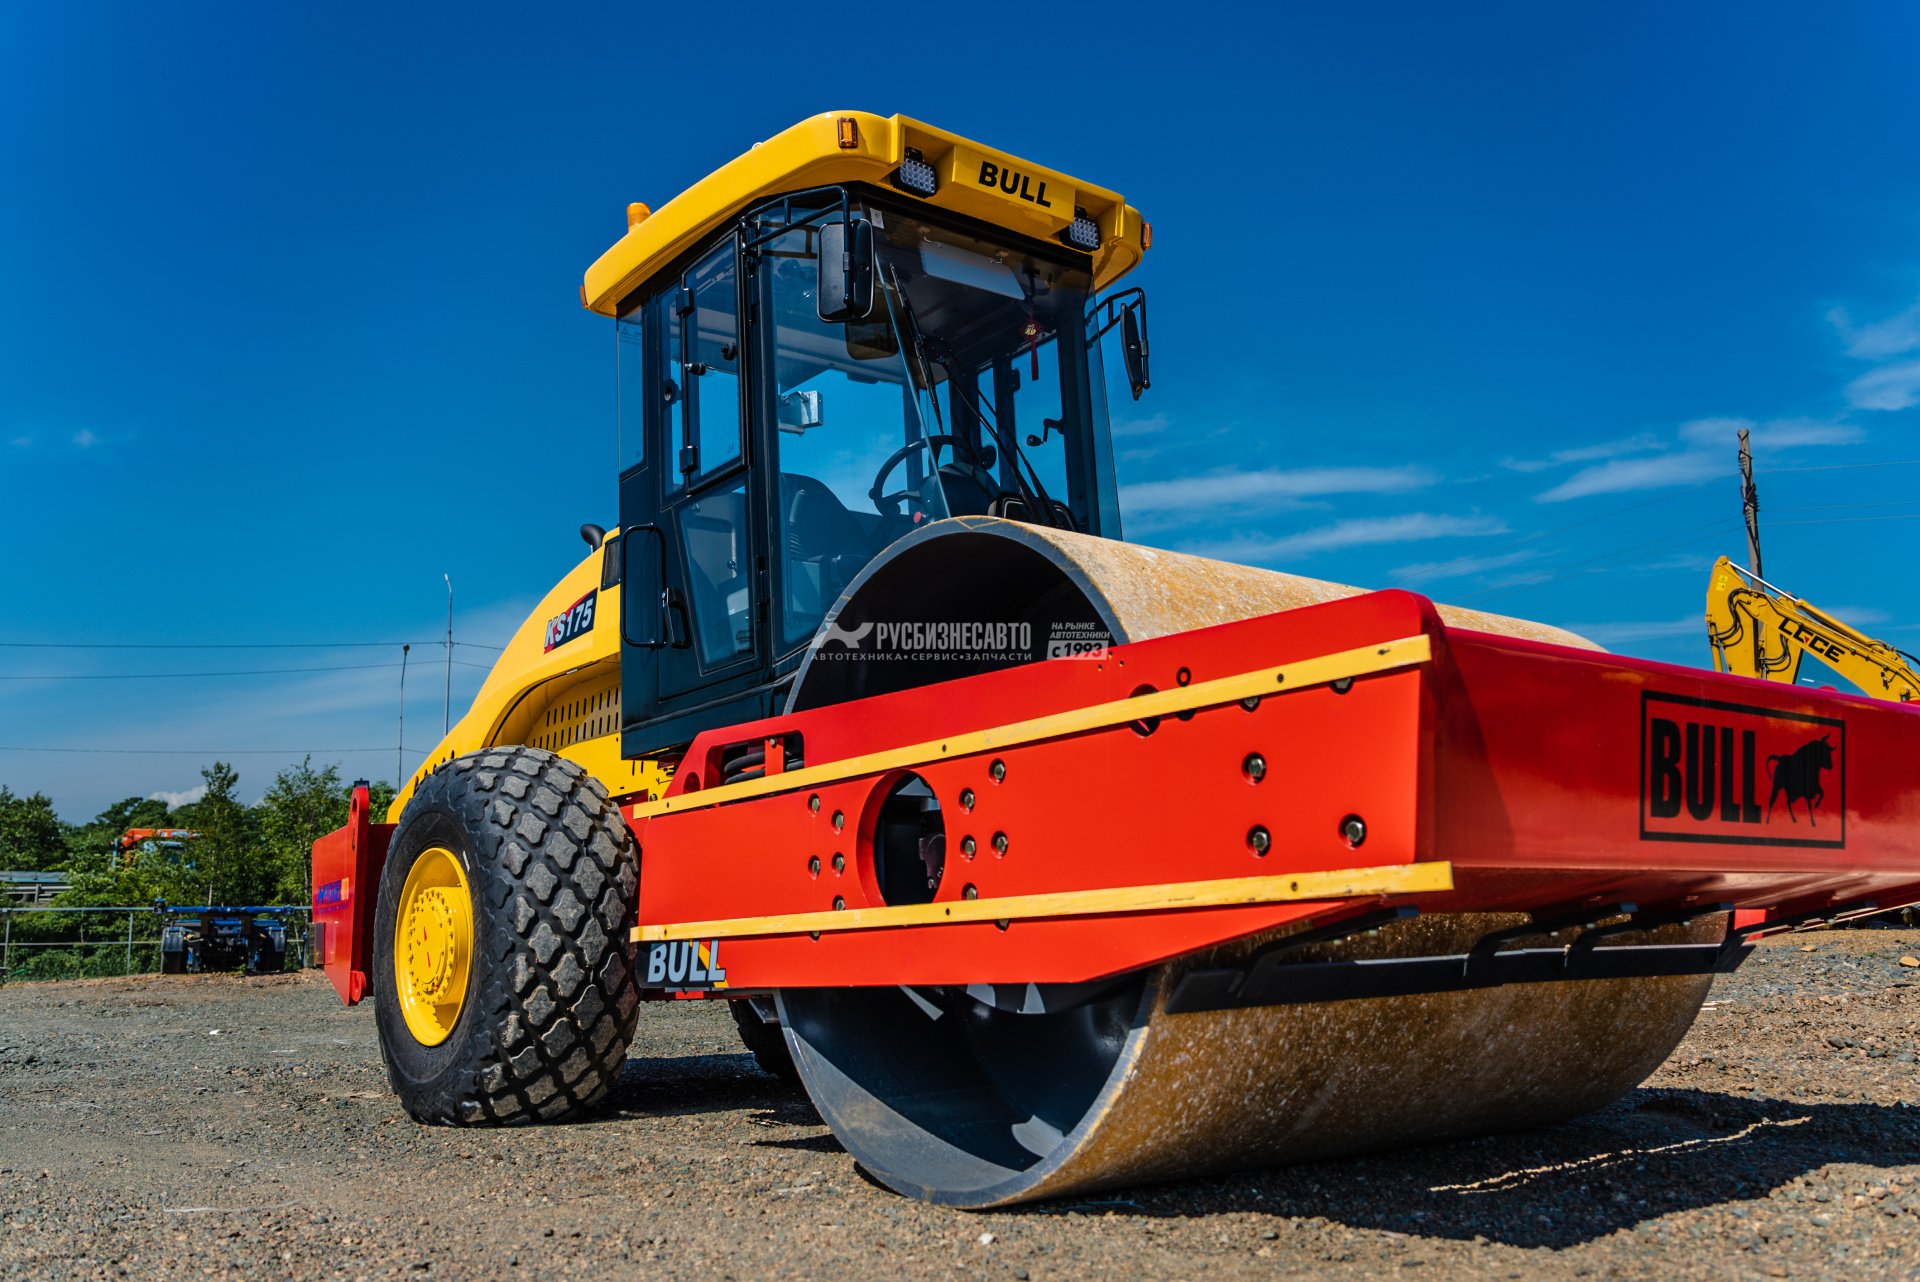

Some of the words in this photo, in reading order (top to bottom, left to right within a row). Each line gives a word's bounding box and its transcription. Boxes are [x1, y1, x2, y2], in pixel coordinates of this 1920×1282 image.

[978, 160, 1052, 209] BULL
[544, 598, 594, 649] KS175
[1650, 717, 1762, 824] BULL
[647, 939, 726, 983] BULL
